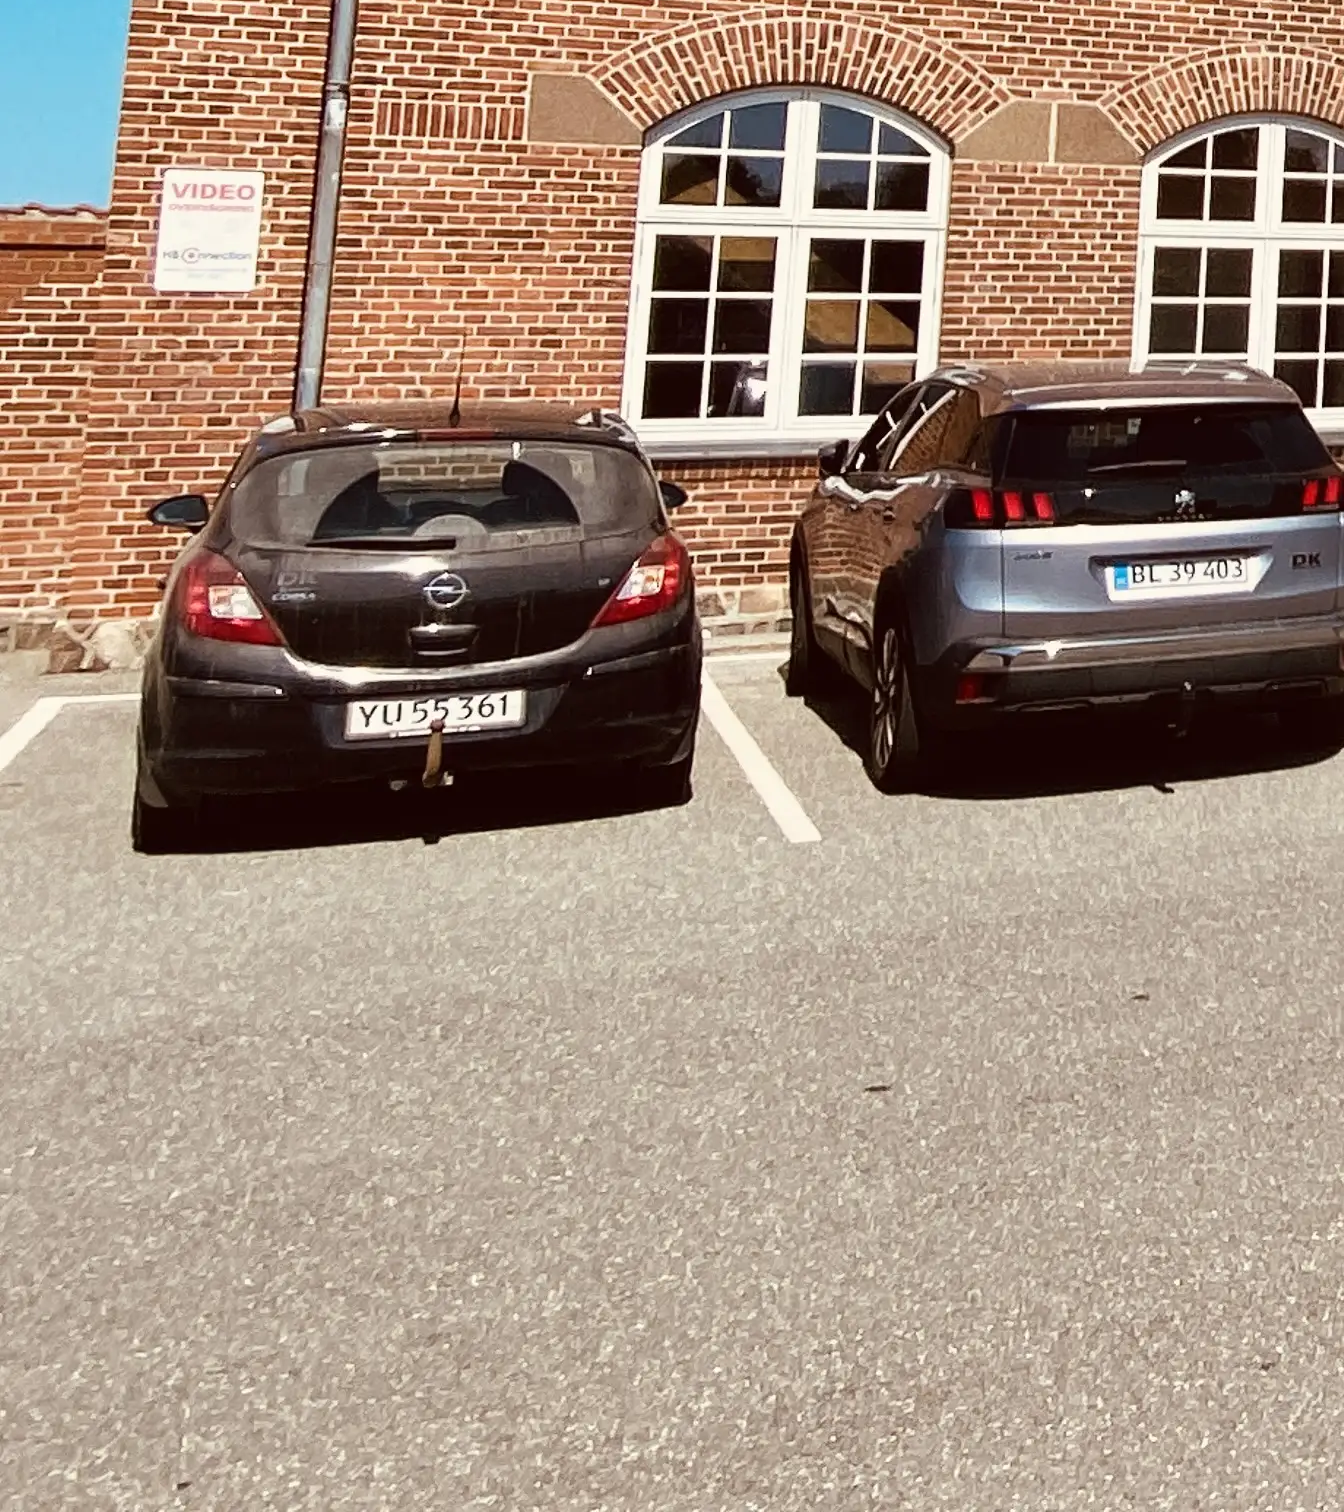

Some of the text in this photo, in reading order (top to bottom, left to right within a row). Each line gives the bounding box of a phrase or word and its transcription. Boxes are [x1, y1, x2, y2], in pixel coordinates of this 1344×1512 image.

[171, 183, 256, 201] VIDEO
[1132, 558, 1243, 584] BL 39 403
[1291, 553, 1321, 569] DK
[360, 694, 507, 728] YU 55 361
